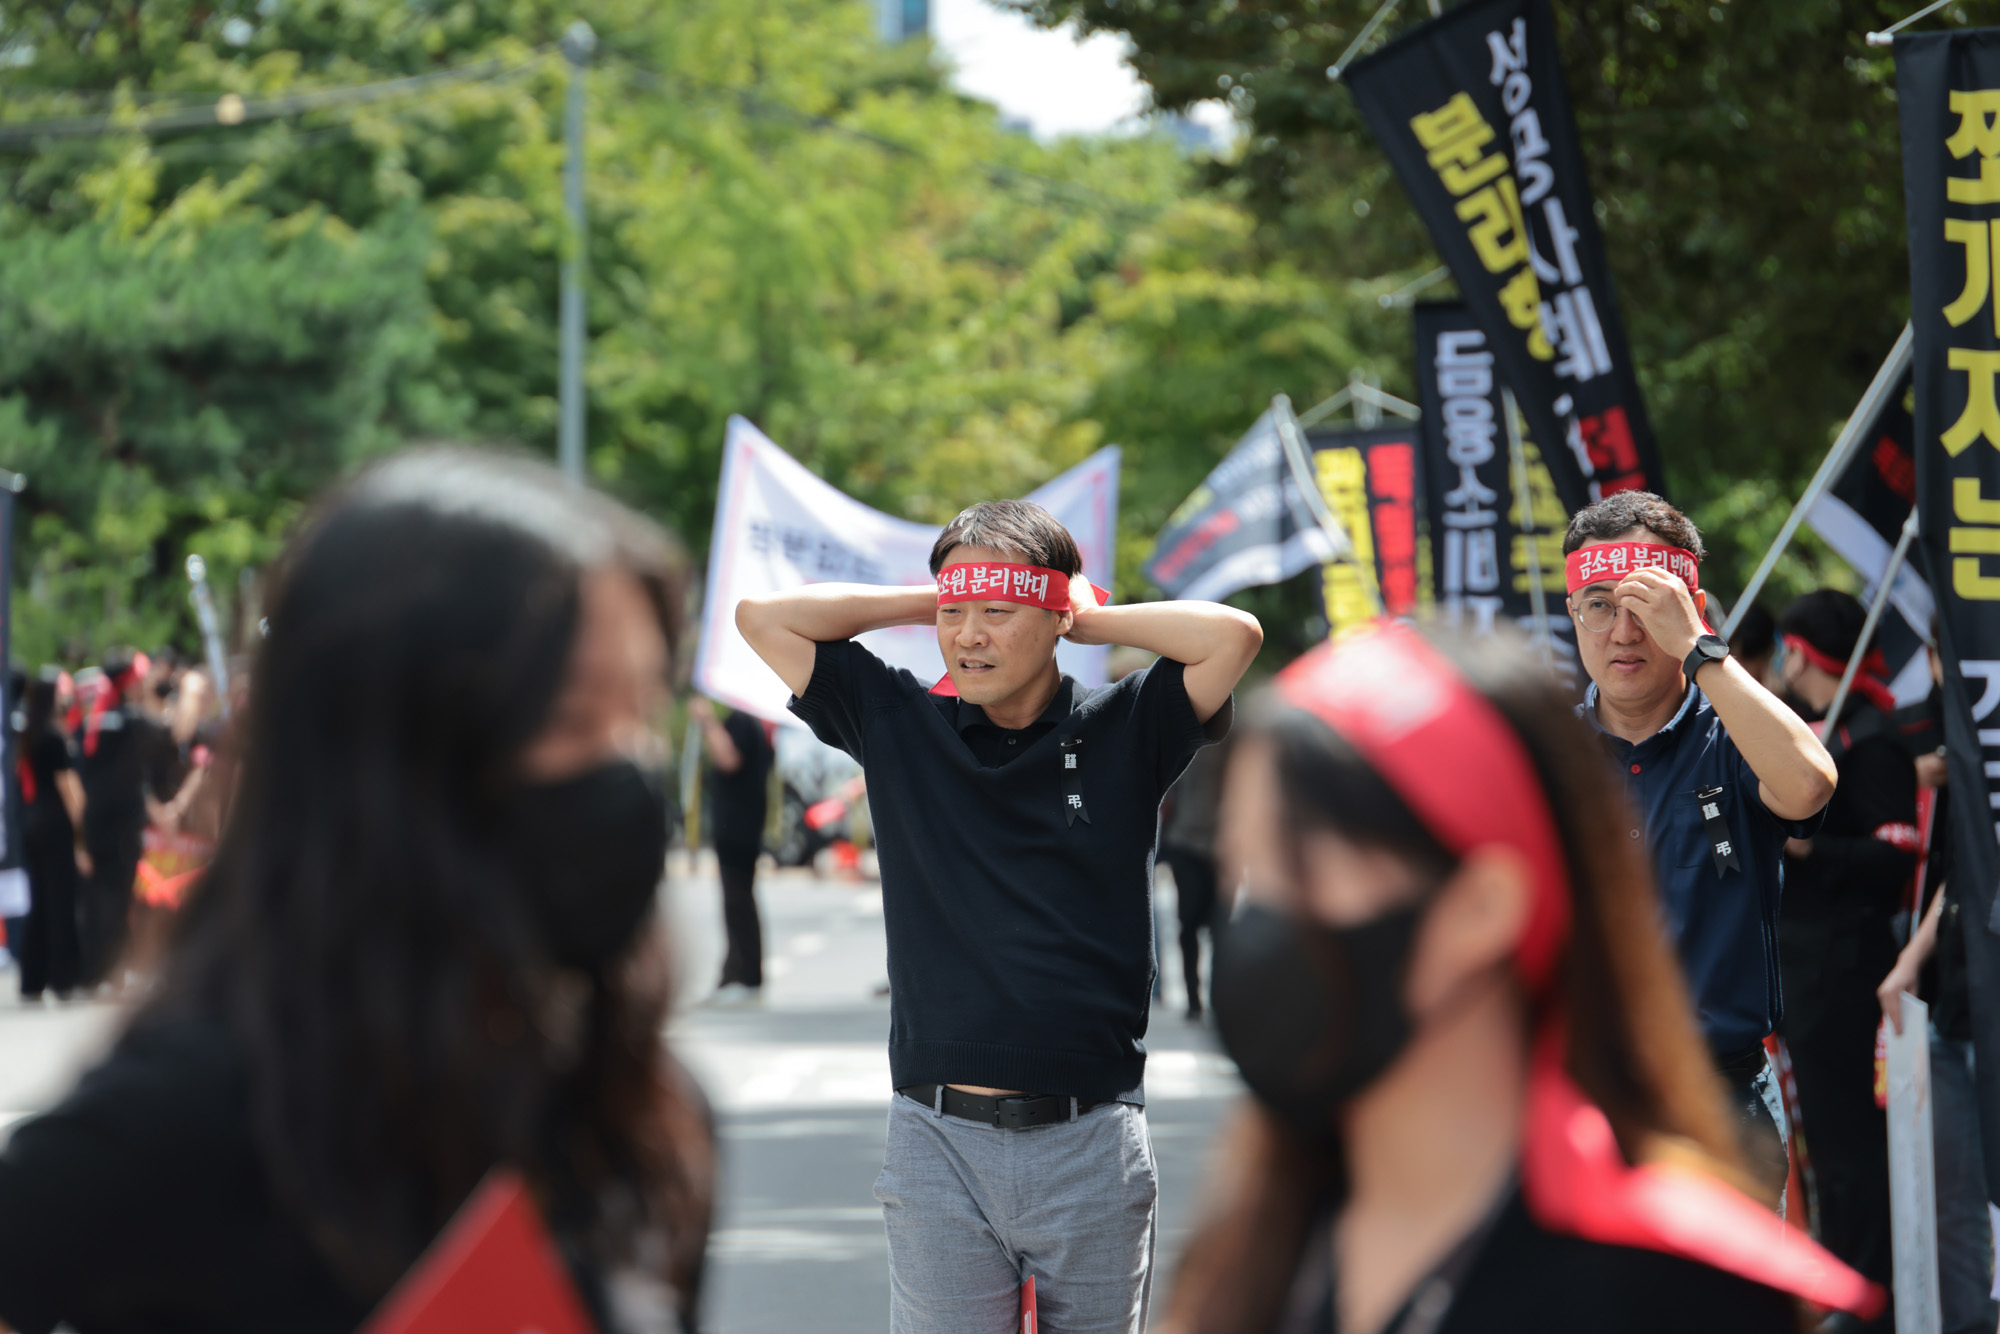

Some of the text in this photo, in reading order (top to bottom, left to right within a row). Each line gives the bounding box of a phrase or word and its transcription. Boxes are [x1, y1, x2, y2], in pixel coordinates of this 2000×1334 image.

[938, 567, 967, 596] 소원
[969, 566, 1010, 595] 분리
[1013, 570, 1049, 602] 반대
[1578, 546, 1695, 586] 금소원 분리 반대
